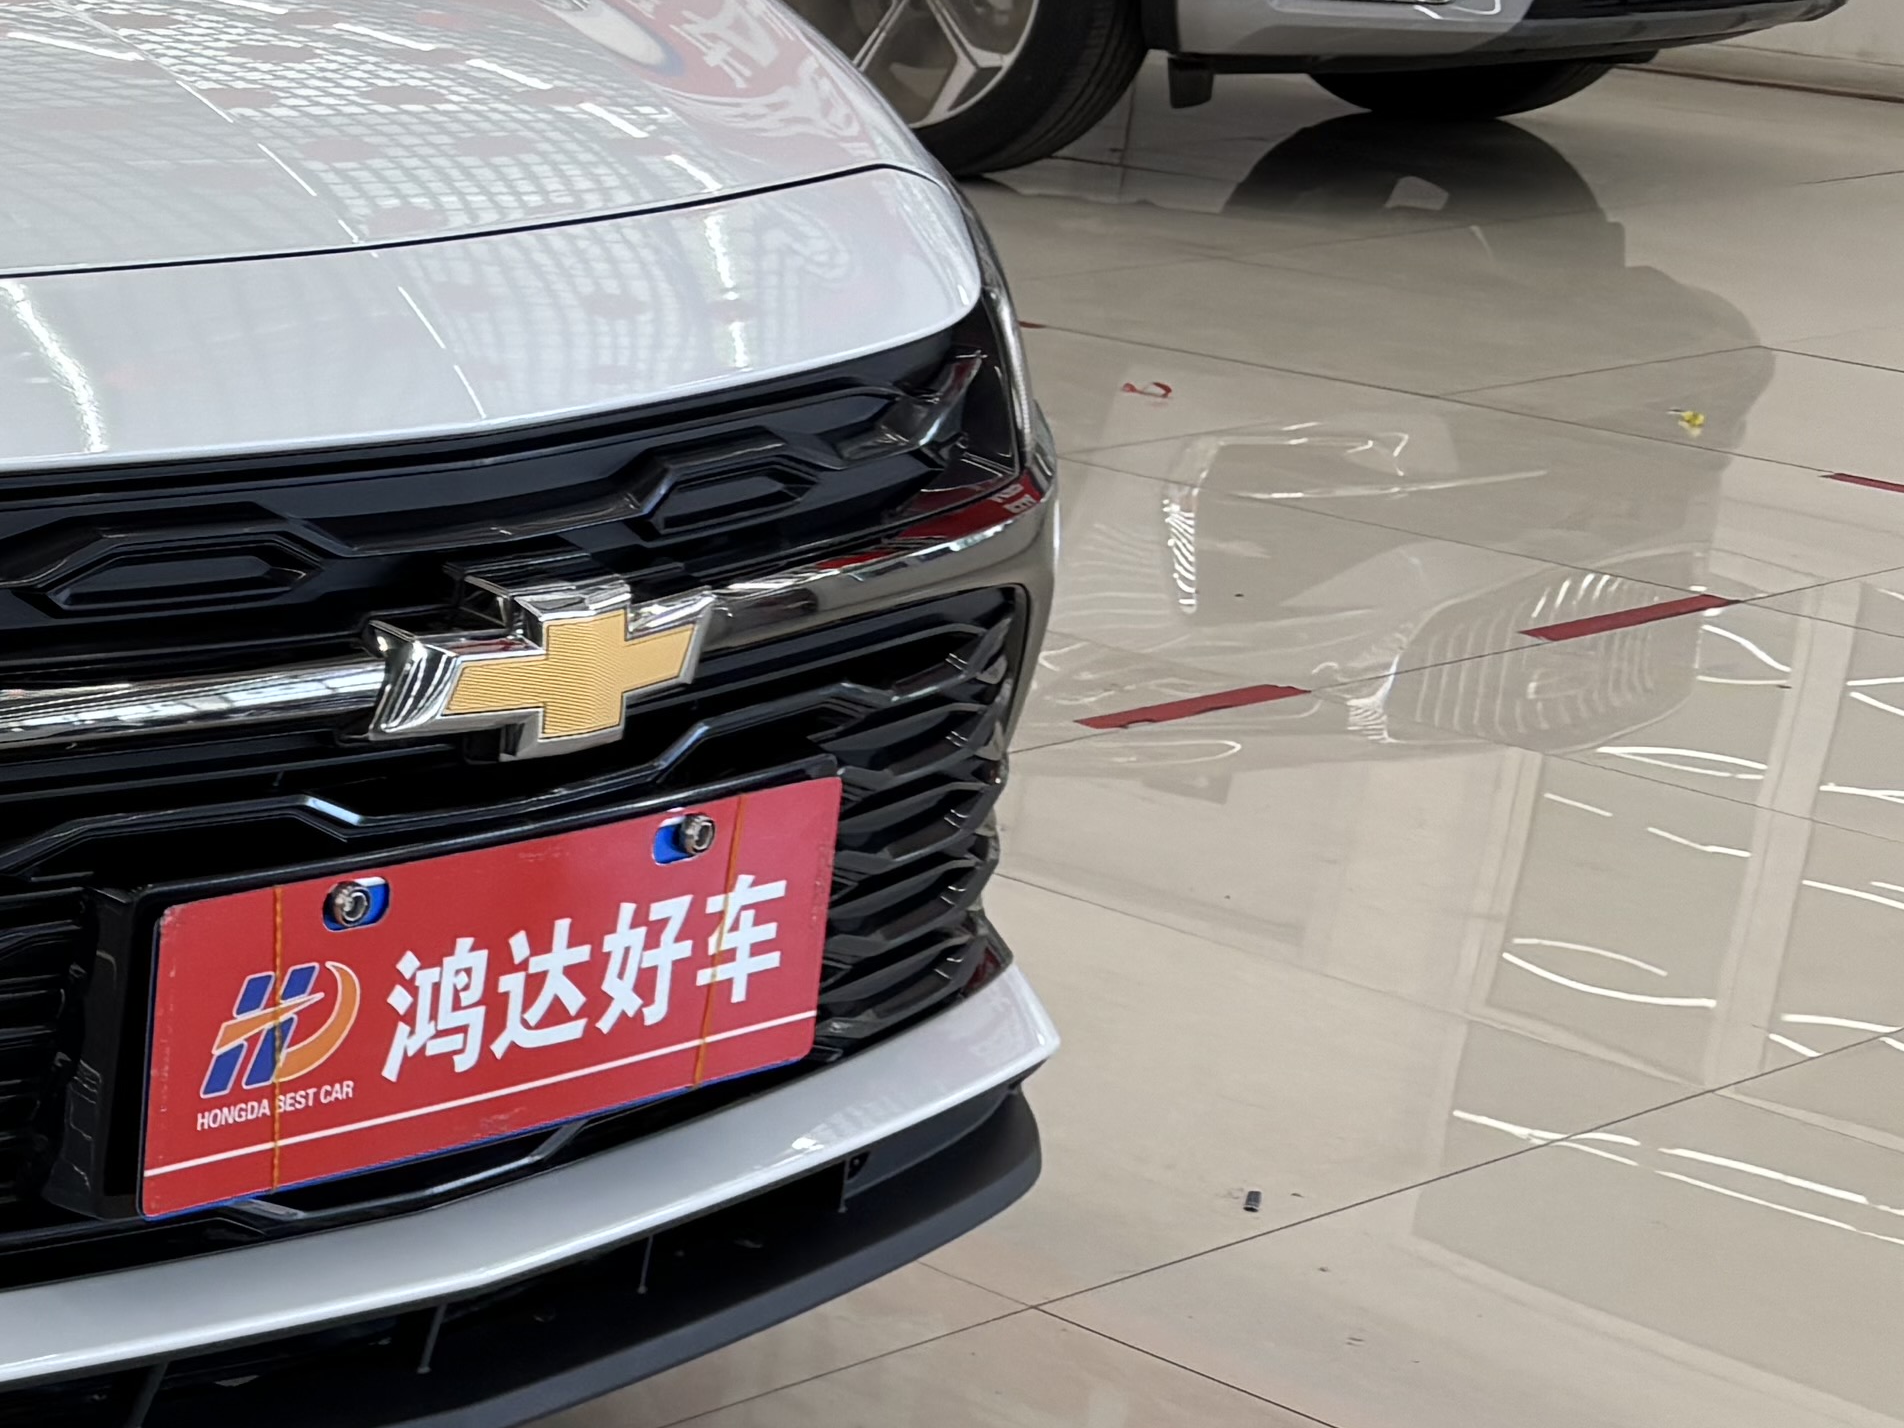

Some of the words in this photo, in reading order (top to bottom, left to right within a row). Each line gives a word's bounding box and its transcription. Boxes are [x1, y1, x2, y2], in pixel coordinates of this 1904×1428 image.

[381, 873, 787, 1082] 鸿达好车
[196, 1098, 271, 1132] HONGDA
[275, 1087, 316, 1114] BEST
[319, 1080, 355, 1105] CAR
